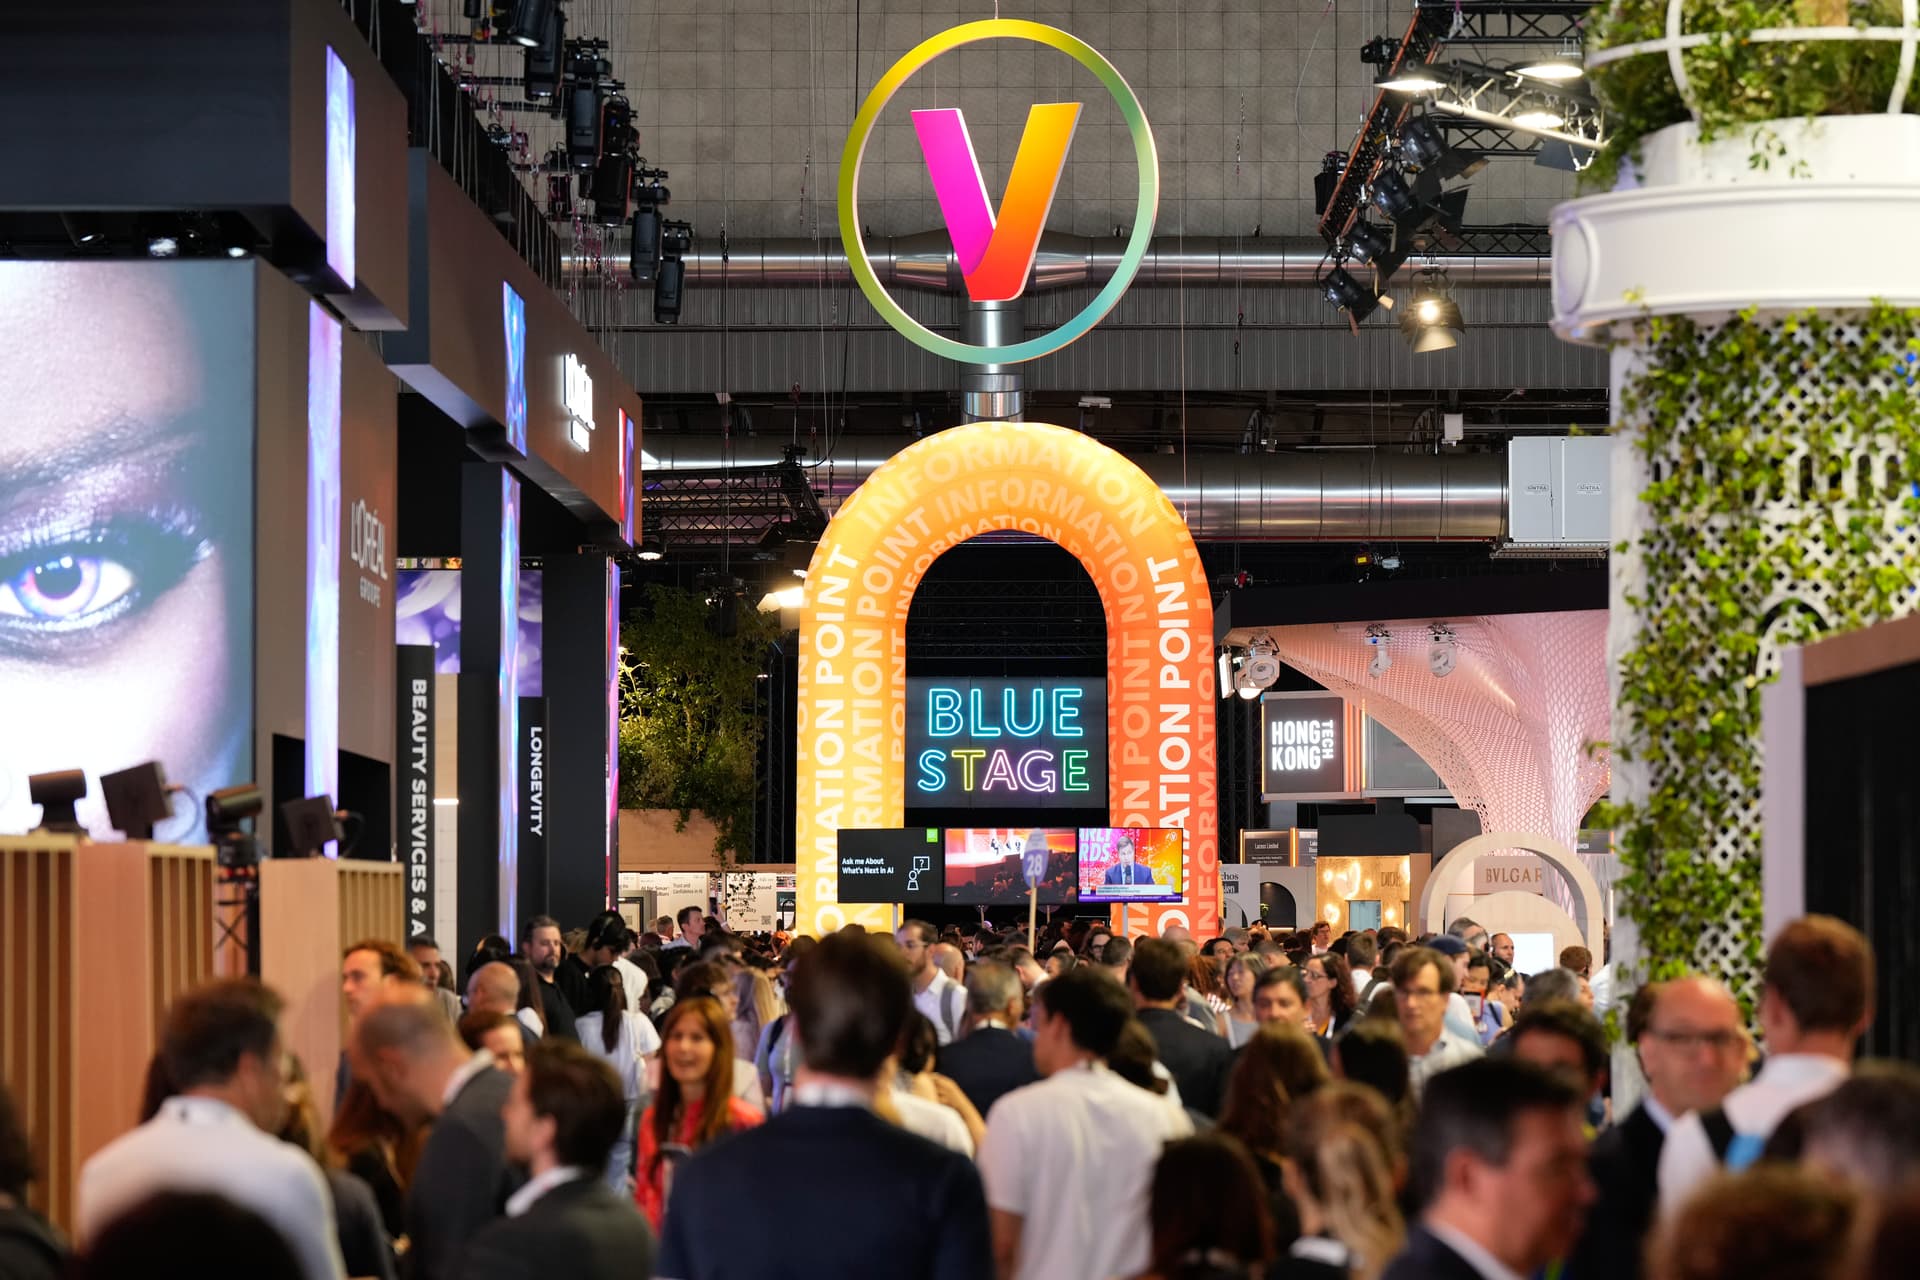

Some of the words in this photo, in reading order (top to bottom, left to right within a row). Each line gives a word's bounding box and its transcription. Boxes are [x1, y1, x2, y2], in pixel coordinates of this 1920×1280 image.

[857, 435, 1157, 537] INFORMATION
[855, 506, 932, 618] POINT
[935, 476, 1148, 623] INFORMATION
[815, 543, 859, 684] POINT
[1146, 557, 1191, 689] POINT
[412, 679, 427, 774] BEAUTY
[928, 688, 1084, 737] BLUE
[1122, 632, 1151, 765] POINT
[1271, 719, 1321, 746] HONG
[1321, 719, 1335, 760] TECH
[530, 726, 543, 837] LONGEVITY
[917, 749, 1090, 792] STAGE
[1271, 745, 1322, 772] KONG
[412, 778, 427, 892] SERVICES
[842, 857, 854, 865] Ask
[865, 857, 884, 865] About
[842, 866, 864, 875] What's
[864, 867, 880, 875] Next
[887, 866, 894, 875] AI
[1026, 854, 1043, 877] 28
[411, 897, 427, 915] &
